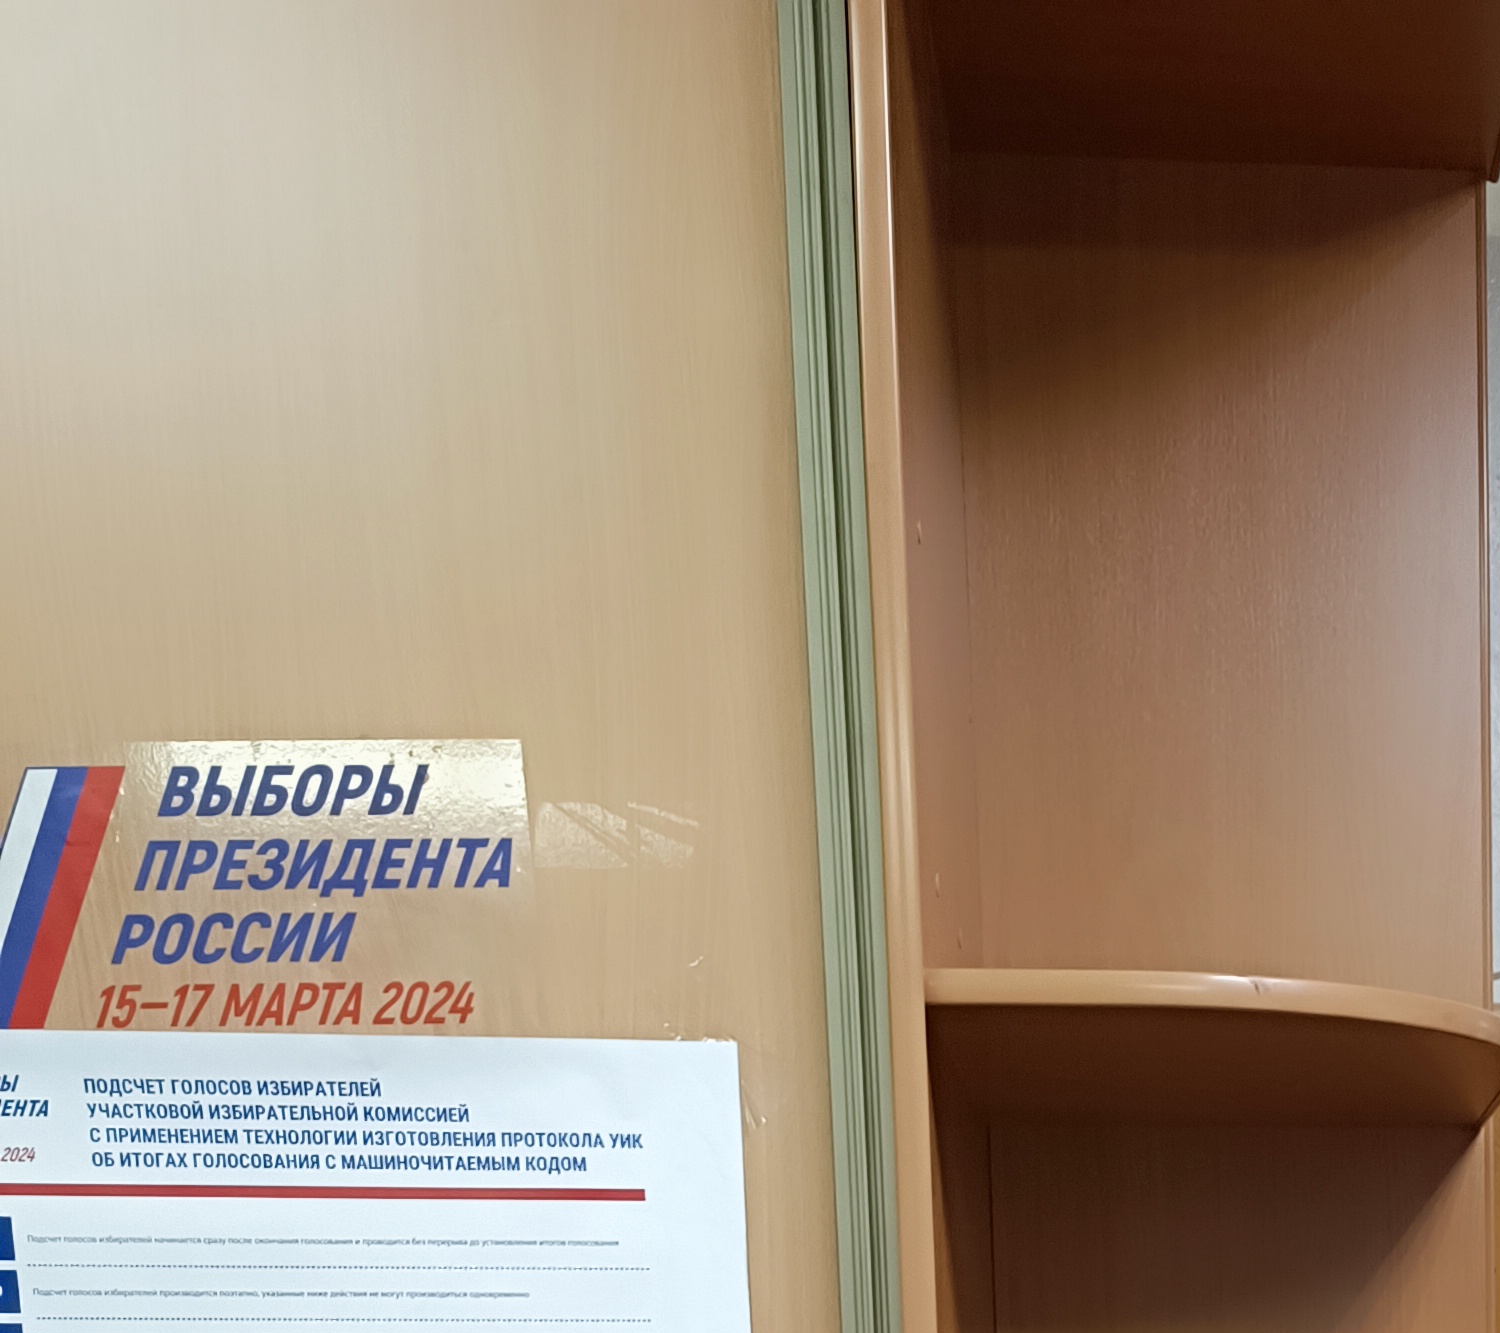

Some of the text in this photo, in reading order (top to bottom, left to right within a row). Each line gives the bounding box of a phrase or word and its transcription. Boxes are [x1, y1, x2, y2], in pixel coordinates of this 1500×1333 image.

[157, 764, 430, 817] ВЫБОРЫ
[134, 836, 514, 897] ПРЕЗИДЕНТА
[111, 912, 358, 966] РОССИИ
[218, 982, 363, 1027] МАРТА
[373, 981, 475, 1025] 2024
[83, 1077, 382, 1098] ПОДСЧЕТ ГОЛОСОВ ИЗБИРАТЕЛЕЙ
[86, 1100, 470, 1123] УЧАСТКОВОЙ ИЗБИРАТЕЛЬНОЙ КОМИССИЕЙ
[89, 1127, 643, 1149] С ПРИМЕНЕНИЕМ ТЕХНОЛОГИИ ИЗГОТОВЛЕНИЯ ПРОТОКОЛА УИК
[1, 1147, 36, 1163] 2024
[91, 1151, 587, 1175] ОБ ИТОГАХ ГОЛОСОВАНИЯ С МАШИНОЧИТАЕМЫМ КОДОМ
